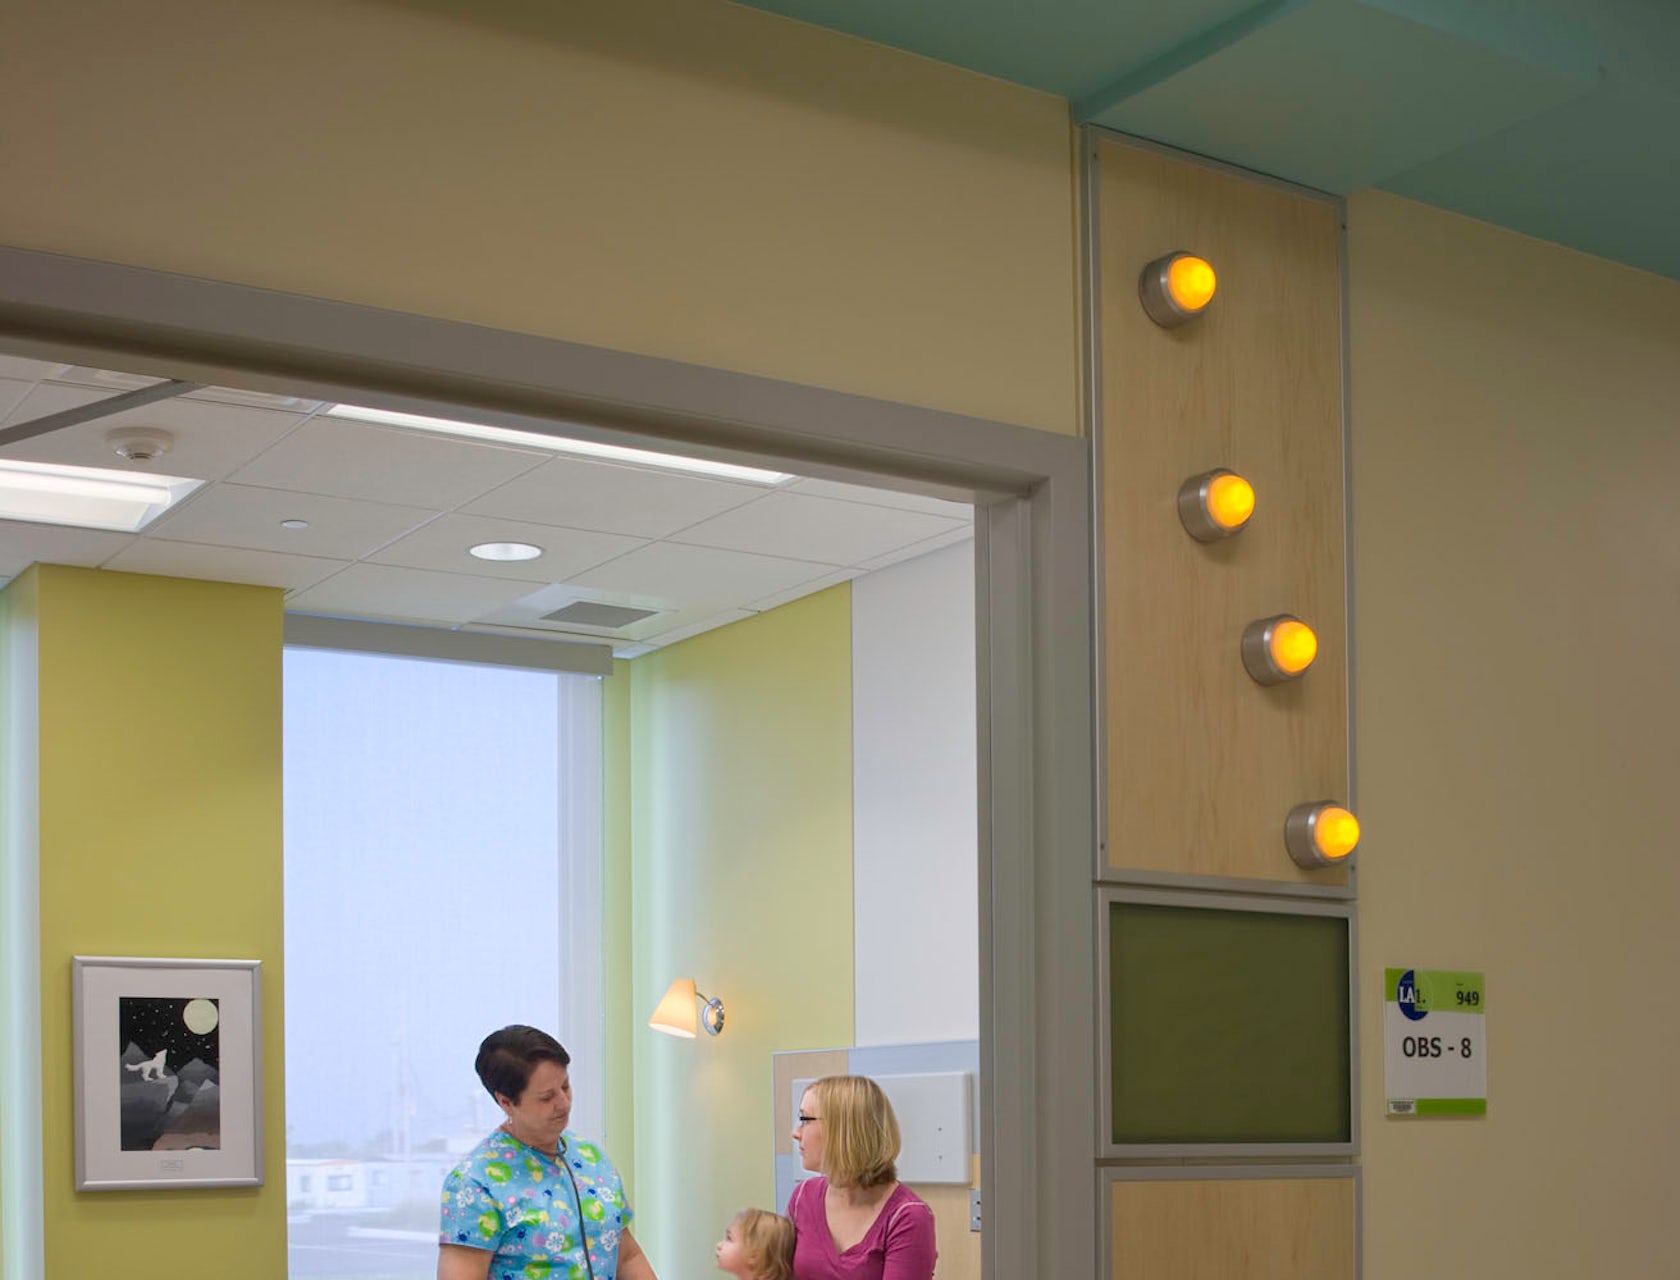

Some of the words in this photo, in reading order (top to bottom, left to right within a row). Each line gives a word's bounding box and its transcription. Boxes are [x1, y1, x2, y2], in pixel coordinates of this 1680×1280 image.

[1456, 990, 1480, 1006] 949
[1402, 1036, 1442, 1058] OBS
[1460, 1037, 1472, 1059] 8
